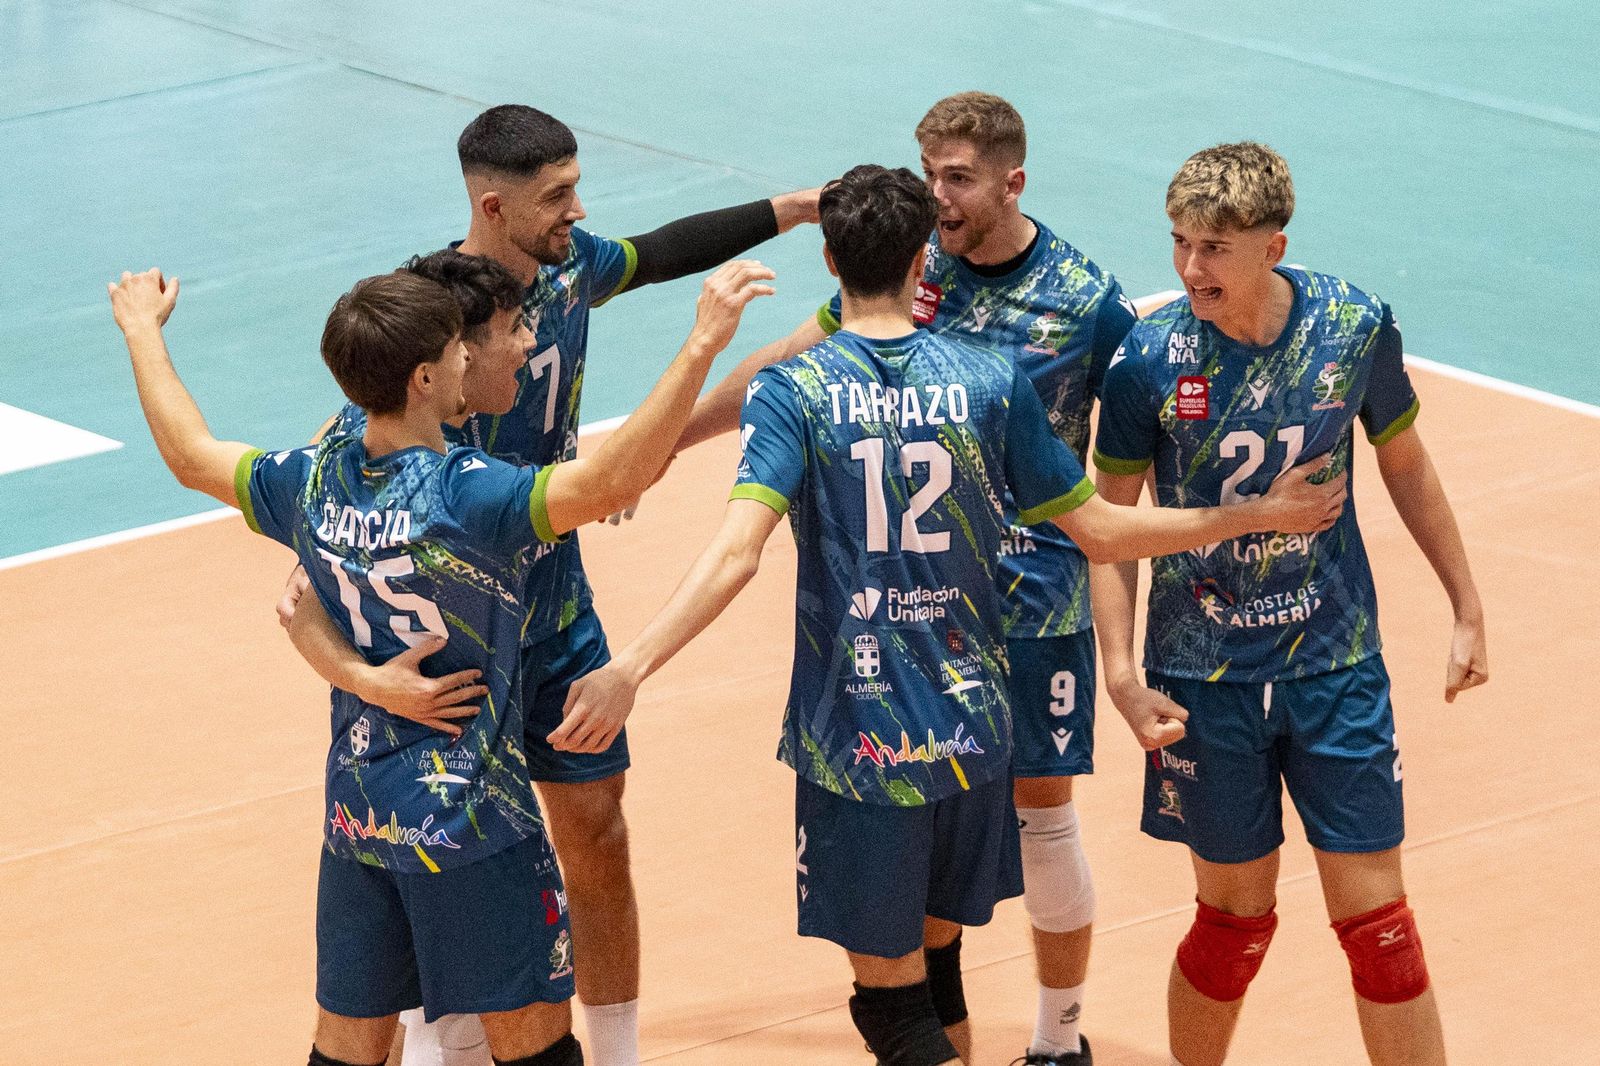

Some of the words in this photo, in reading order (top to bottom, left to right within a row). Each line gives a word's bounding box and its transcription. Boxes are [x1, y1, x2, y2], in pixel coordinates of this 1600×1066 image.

[529, 343, 561, 435] 7
[826, 382, 969, 428] TARRAZO
[1219, 425, 1305, 506] 21
[850, 437, 952, 554] 12
[316, 499, 411, 551] GARCÍA
[1233, 532, 1318, 563] Unicaj
[316, 547, 450, 648] 15
[888, 585, 960, 605] Fundacón
[1244, 591, 1296, 614] COSTA
[1297, 581, 1319, 601] DE
[940, 655, 982, 672] DUTACIÓN
[845, 680, 893, 694] ALMERÍA
[1050, 671, 1076, 716] 9
[421, 749, 477, 760] DUTACIÓN
[853, 722, 985, 768] Andalucía
[330, 800, 462, 850] Andalucía
